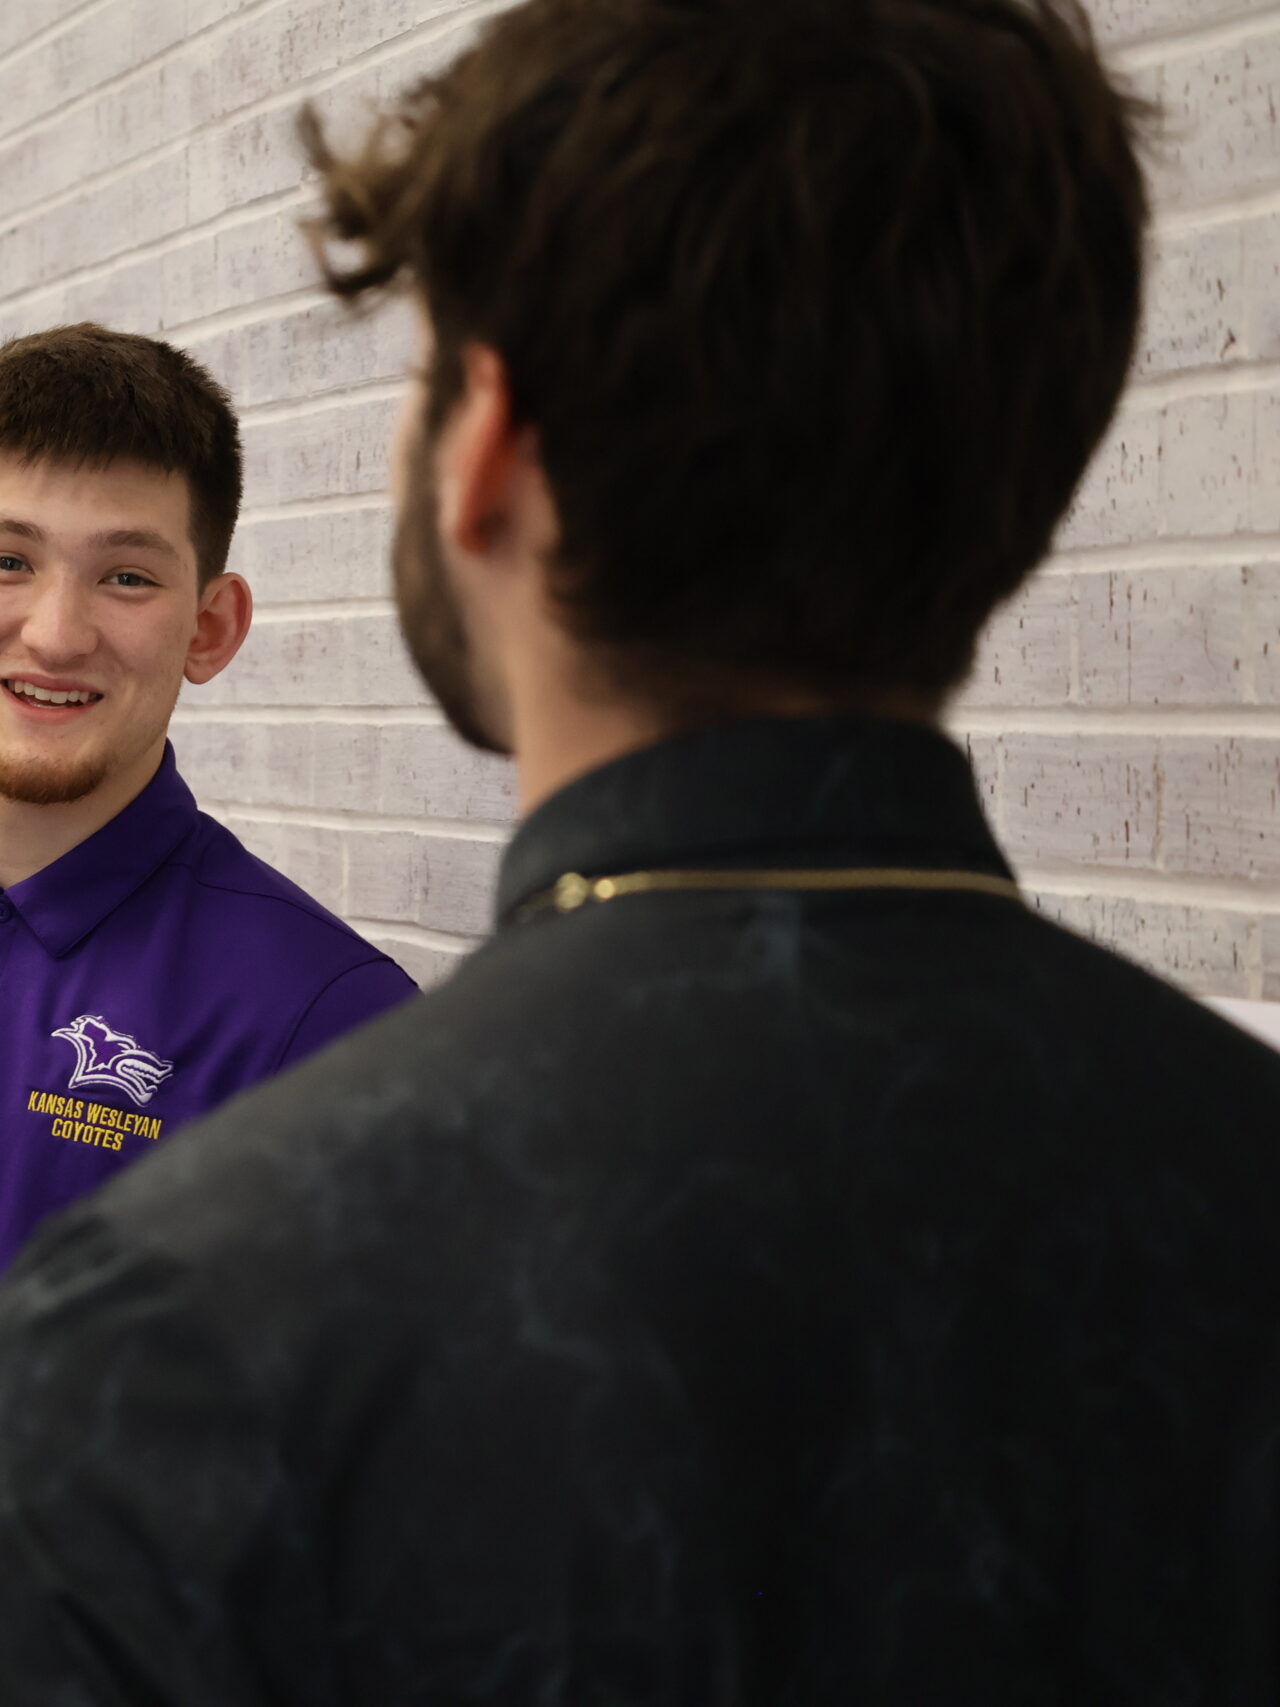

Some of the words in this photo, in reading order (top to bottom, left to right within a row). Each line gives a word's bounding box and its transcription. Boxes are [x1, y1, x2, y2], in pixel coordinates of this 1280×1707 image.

[27, 1090, 84, 1119] KANSAS
[86, 1102, 162, 1140] WESLEYAN
[51, 1118, 125, 1151] COYOTES
